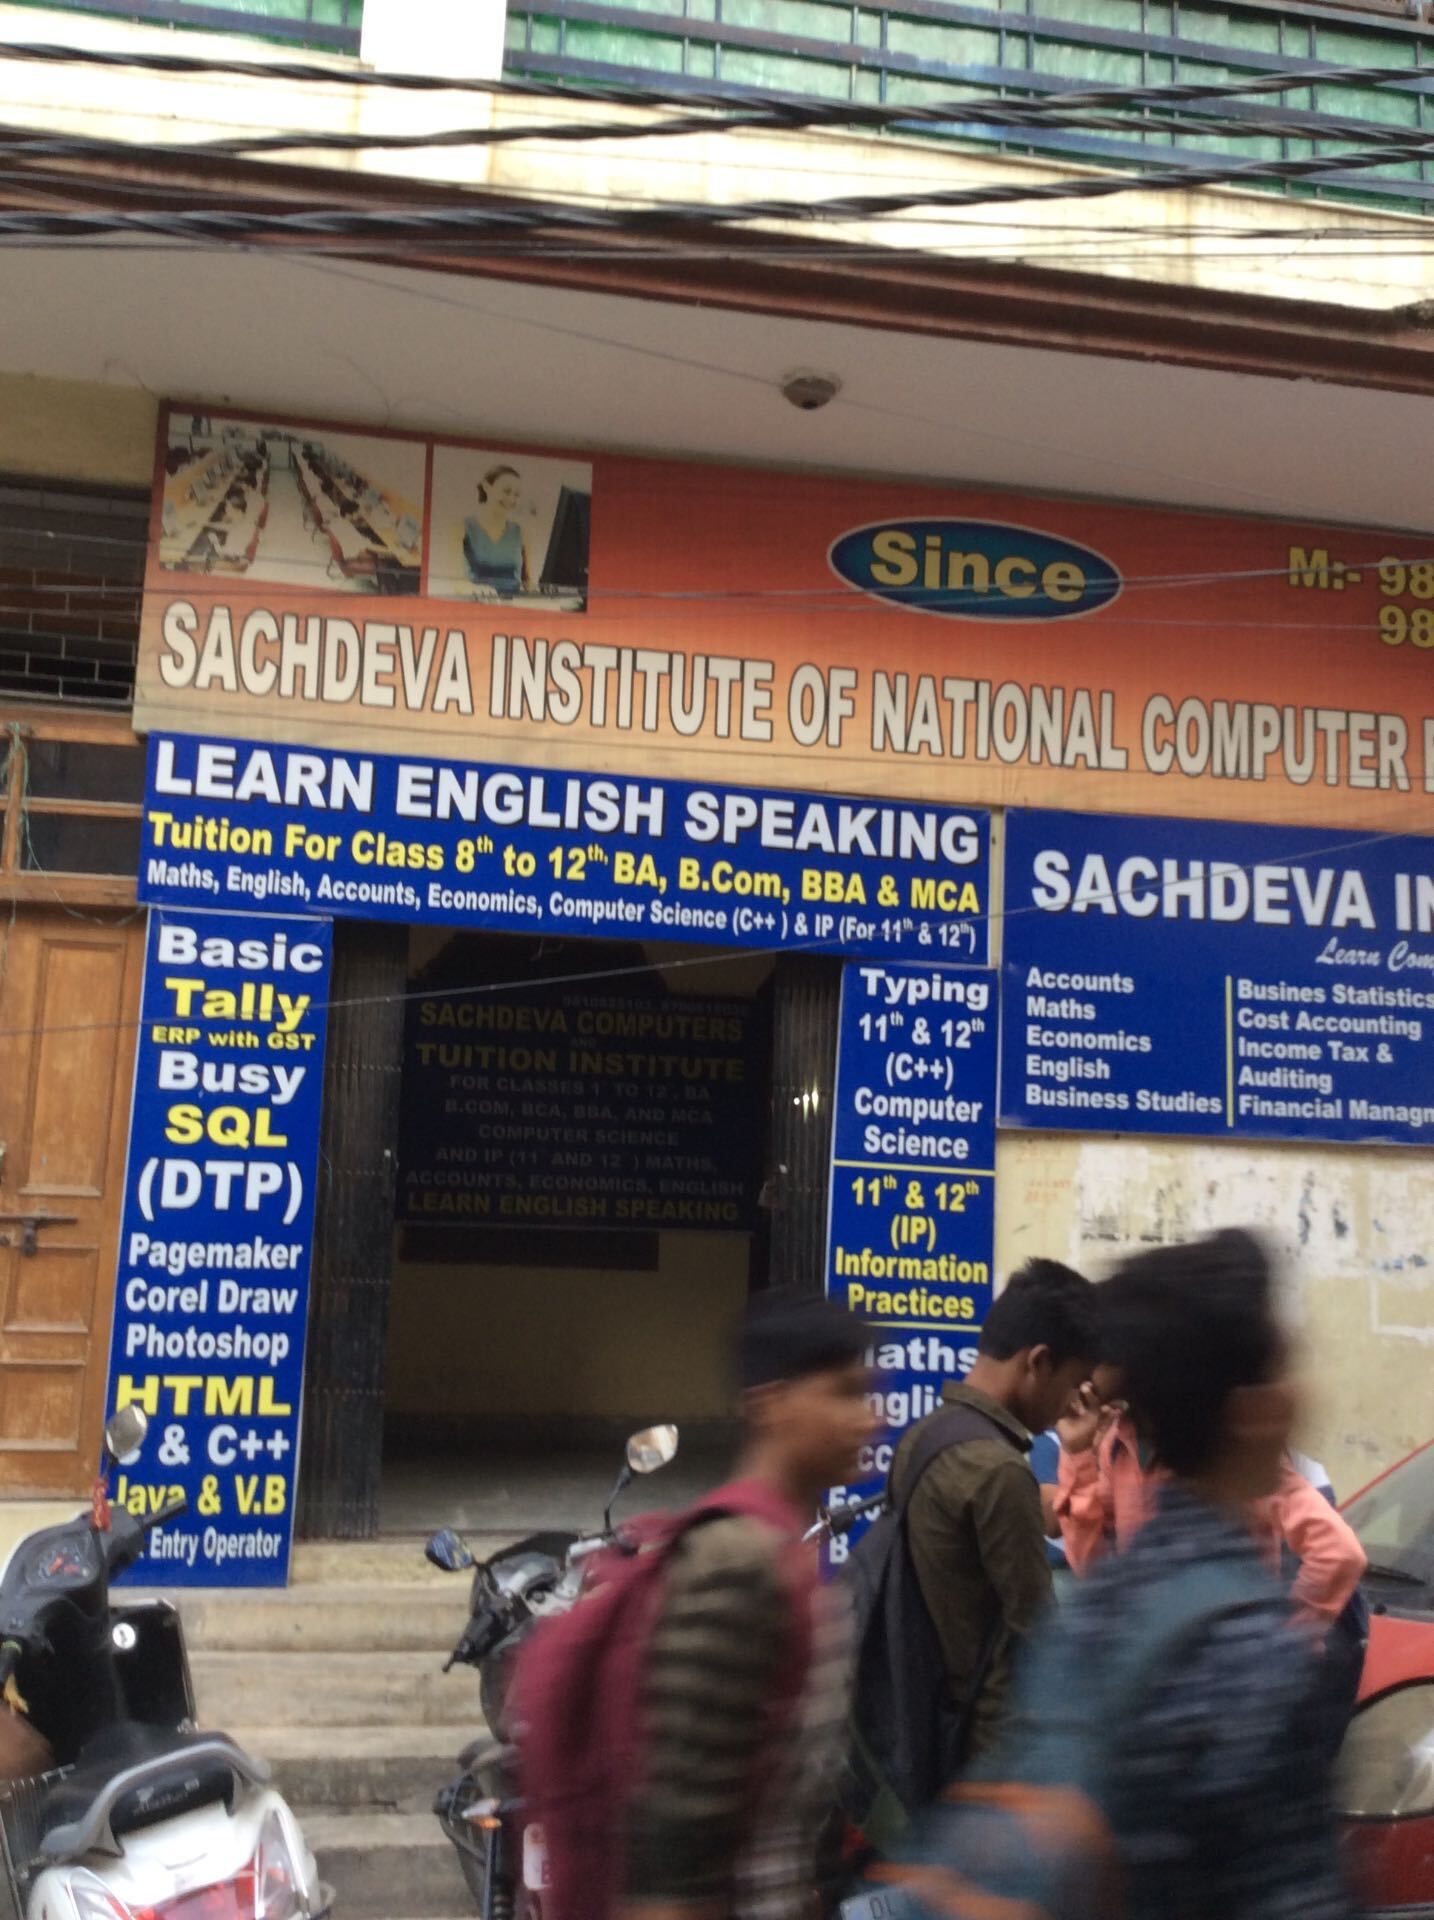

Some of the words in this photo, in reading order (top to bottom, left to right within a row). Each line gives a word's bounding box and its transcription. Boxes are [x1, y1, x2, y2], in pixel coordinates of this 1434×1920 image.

[870, 530, 1086, 602] Since
[1380, 605, 1434, 648] 98
[158, 601, 474, 715] SACHDEVA
[489, 634, 774, 742] INSTITUTE
[788, 662, 857, 748] OF
[871, 669, 1129, 772] NATIONAL
[1141, 693, 1410, 793] COMPUTER
[154, 740, 375, 813] LEARN
[395, 763, 665, 837] ENGLISH
[684, 790, 980, 865] SPEAKING
[147, 811, 273, 856] Tuition
[284, 824, 342, 861] For
[350, 830, 445, 871] Class
[455, 835, 494, 873] 8th
[503, 843, 536, 877] to
[614, 851, 668, 895] BA,
[678, 857, 791, 905] B.Com,
[801, 868, 867, 905] BBA
[877, 875, 900, 907] &
[910, 877, 980, 914] MCA
[147, 858, 219, 895] Maths,
[226, 865, 311, 902] English,
[317, 873, 421, 911] Accounts,
[428, 883, 543, 919] Economics,
[549, 891, 645, 925] Computer
[650, 899, 727, 929] Science
[794, 912, 808, 937] &
[814, 914, 834, 938] IP
[838, 916, 876, 944] (For
[881, 916, 913, 943] 11th
[918, 922, 932, 945] &
[1032, 849, 1377, 929] SACHDEVA
[157, 924, 323, 973] Basic
[1315, 936, 1381, 967] Learn
[859, 967, 989, 1011] Typing
[1026, 966, 1135, 994] Accounts
[1237, 979, 1326, 1005] Busines
[1332, 984, 1434, 1010] Statistics
[164, 977, 311, 1032] Tally
[420, 1001, 568, 1033] SACHDEVA
[577, 1010, 744, 1041] COMPUTERS
[1026, 996, 1096, 1020] Maths
[151, 1025, 201, 1045] ERP
[208, 1030, 260, 1049] with
[267, 1032, 316, 1051] GST
[859, 1011, 904, 1043] 11th
[912, 1017, 931, 1045] &
[941, 1017, 986, 1049] 12th
[1026, 1025, 1152, 1053] Economics
[1237, 1007, 1289, 1031] Cost
[1296, 1010, 1422, 1041] Accounting
[416, 1043, 557, 1072] TUITION
[570, 1051, 745, 1081] INSTITUTE
[1026, 1054, 1110, 1082] English
[1237, 1036, 1322, 1061] Income
[1327, 1040, 1369, 1062] Tax
[1376, 1042, 1393, 1063] &
[158, 1049, 306, 1105] Busy
[496, 1077, 585, 1097] CLASSES
[886, 1052, 954, 1091] (C++)
[1238, 1065, 1332, 1095] Auditing
[854, 1086, 983, 1126] Computer
[1025, 1084, 1129, 1110] Business
[1136, 1088, 1222, 1114] Studies
[1238, 1094, 1342, 1120] Financial
[164, 1103, 288, 1149] SQL
[478, 1124, 588, 1145] COMPUTER
[595, 1131, 680, 1147] SCIENCE
[864, 1124, 969, 1160] Science
[435, 1148, 478, 1163] AND
[551, 1153, 593, 1168] AND
[138, 1157, 303, 1225] (DTP)
[407, 1191, 491, 1214] LEARN
[499, 1195, 607, 1217] ENGLISH
[614, 1199, 738, 1221] SPEAKING
[658, 1179, 744, 1197] ENGLISH
[852, 1174, 897, 1206] 11th
[905, 1180, 925, 1209] &
[935, 1180, 980, 1212] 12th
[890, 1214, 937, 1253] (IP)
[128, 1232, 303, 1276] Pagemaker
[835, 1246, 988, 1284] Information
[125, 1277, 208, 1313] Corel
[217, 1279, 299, 1314] Draw
[848, 1282, 975, 1320] Practices
[126, 1322, 289, 1367] Photoshop
[115, 1374, 291, 1416] HTML
[158, 1423, 190, 1466] &
[207, 1423, 290, 1466] C++
[197, 1474, 222, 1516] &
[234, 1474, 286, 1515] V.B
[150, 1526, 199, 1567] Entry
[203, 1525, 282, 1566] Operator
